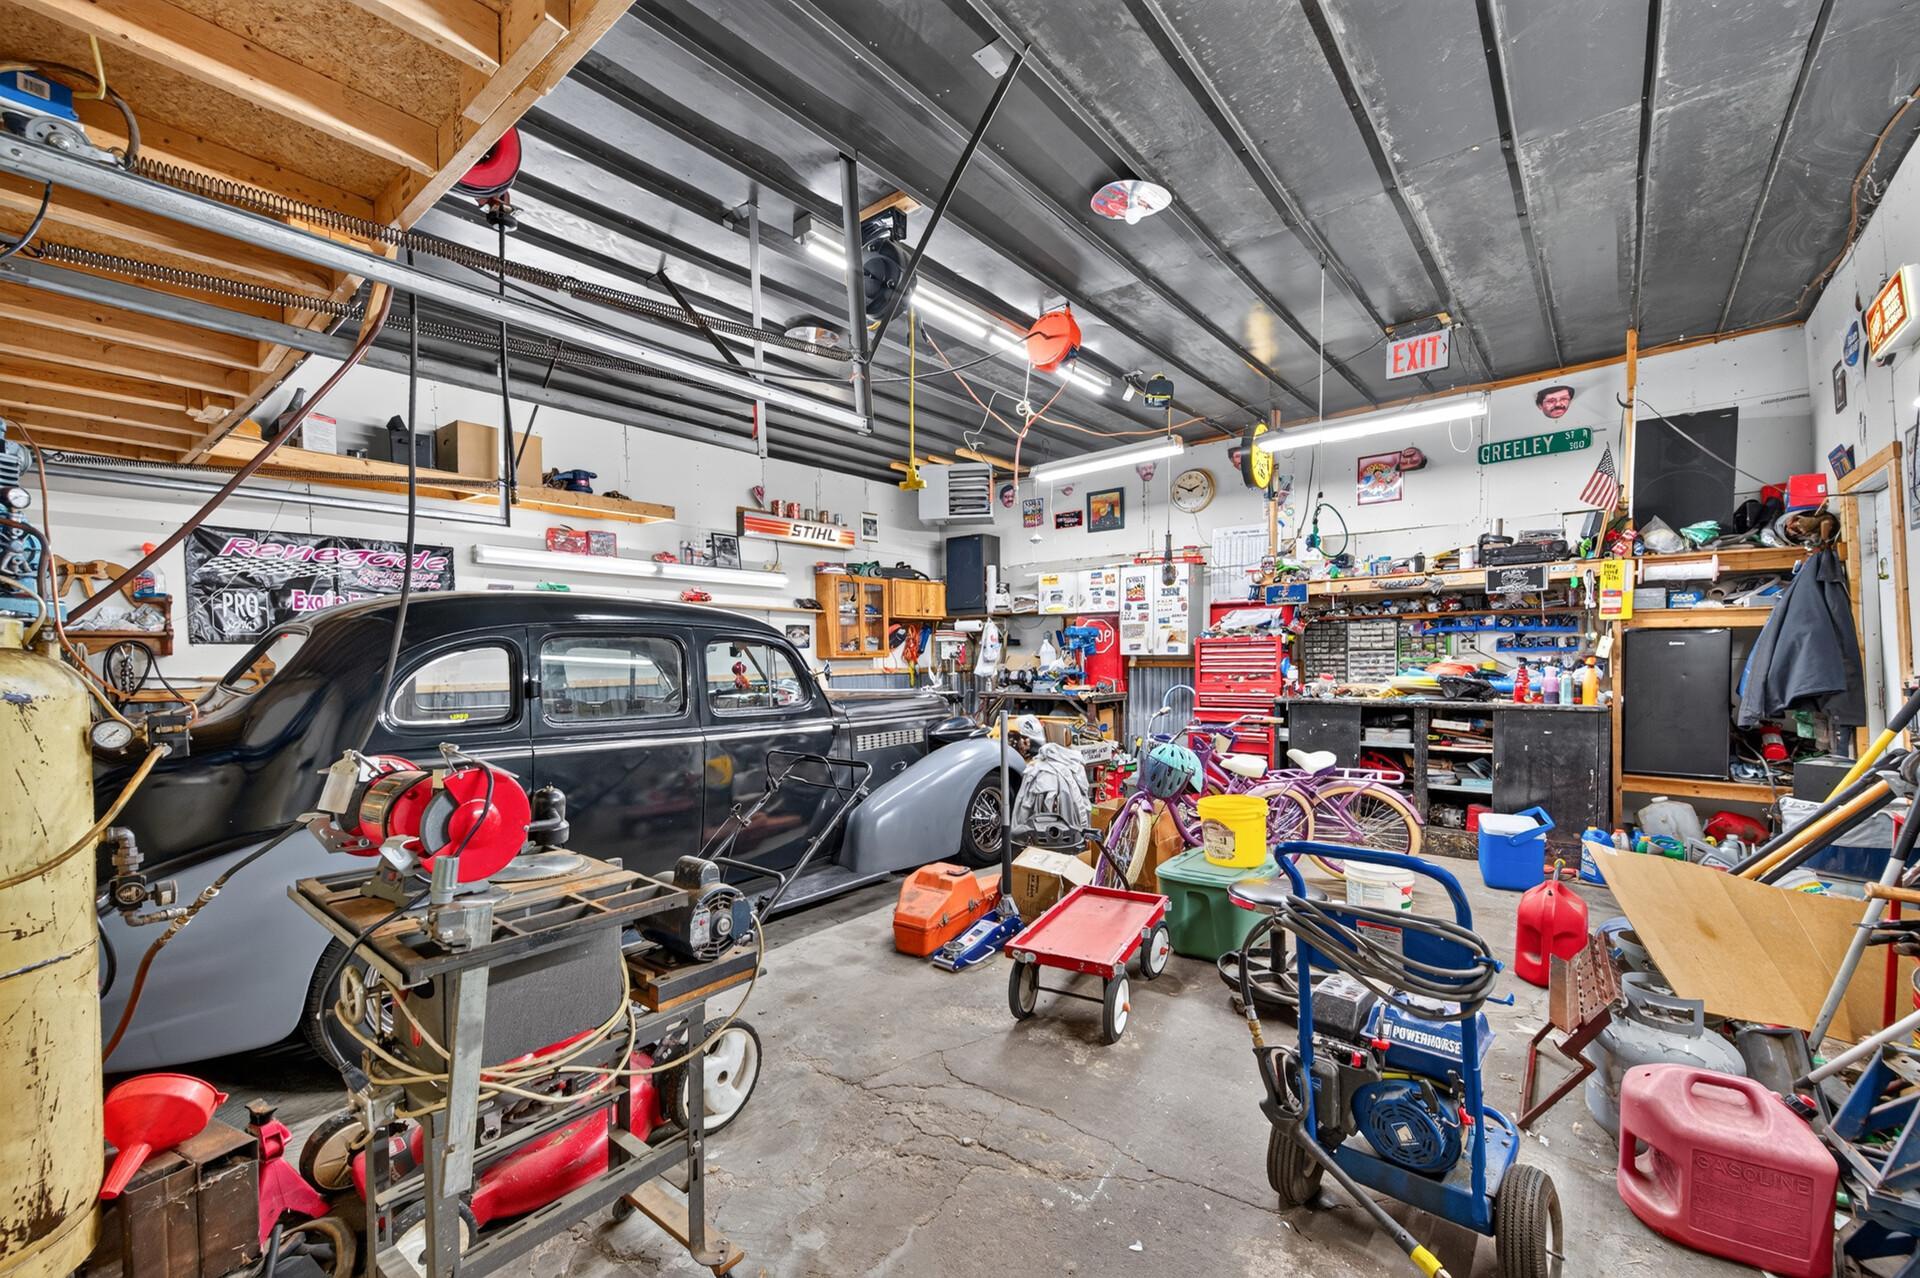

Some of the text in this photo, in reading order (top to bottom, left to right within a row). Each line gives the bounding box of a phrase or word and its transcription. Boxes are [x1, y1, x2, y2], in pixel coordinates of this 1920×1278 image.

[1393, 335, 1442, 374] EXIT
[1481, 435, 1554, 463] GREELEY
[792, 525, 836, 542] STIHL
[218, 537, 449, 571] Renegade
[222, 591, 259, 619] PRO
[1392, 1025, 1462, 1055] POWERHORSE
[1695, 1154, 1809, 1196] GASOLINE
